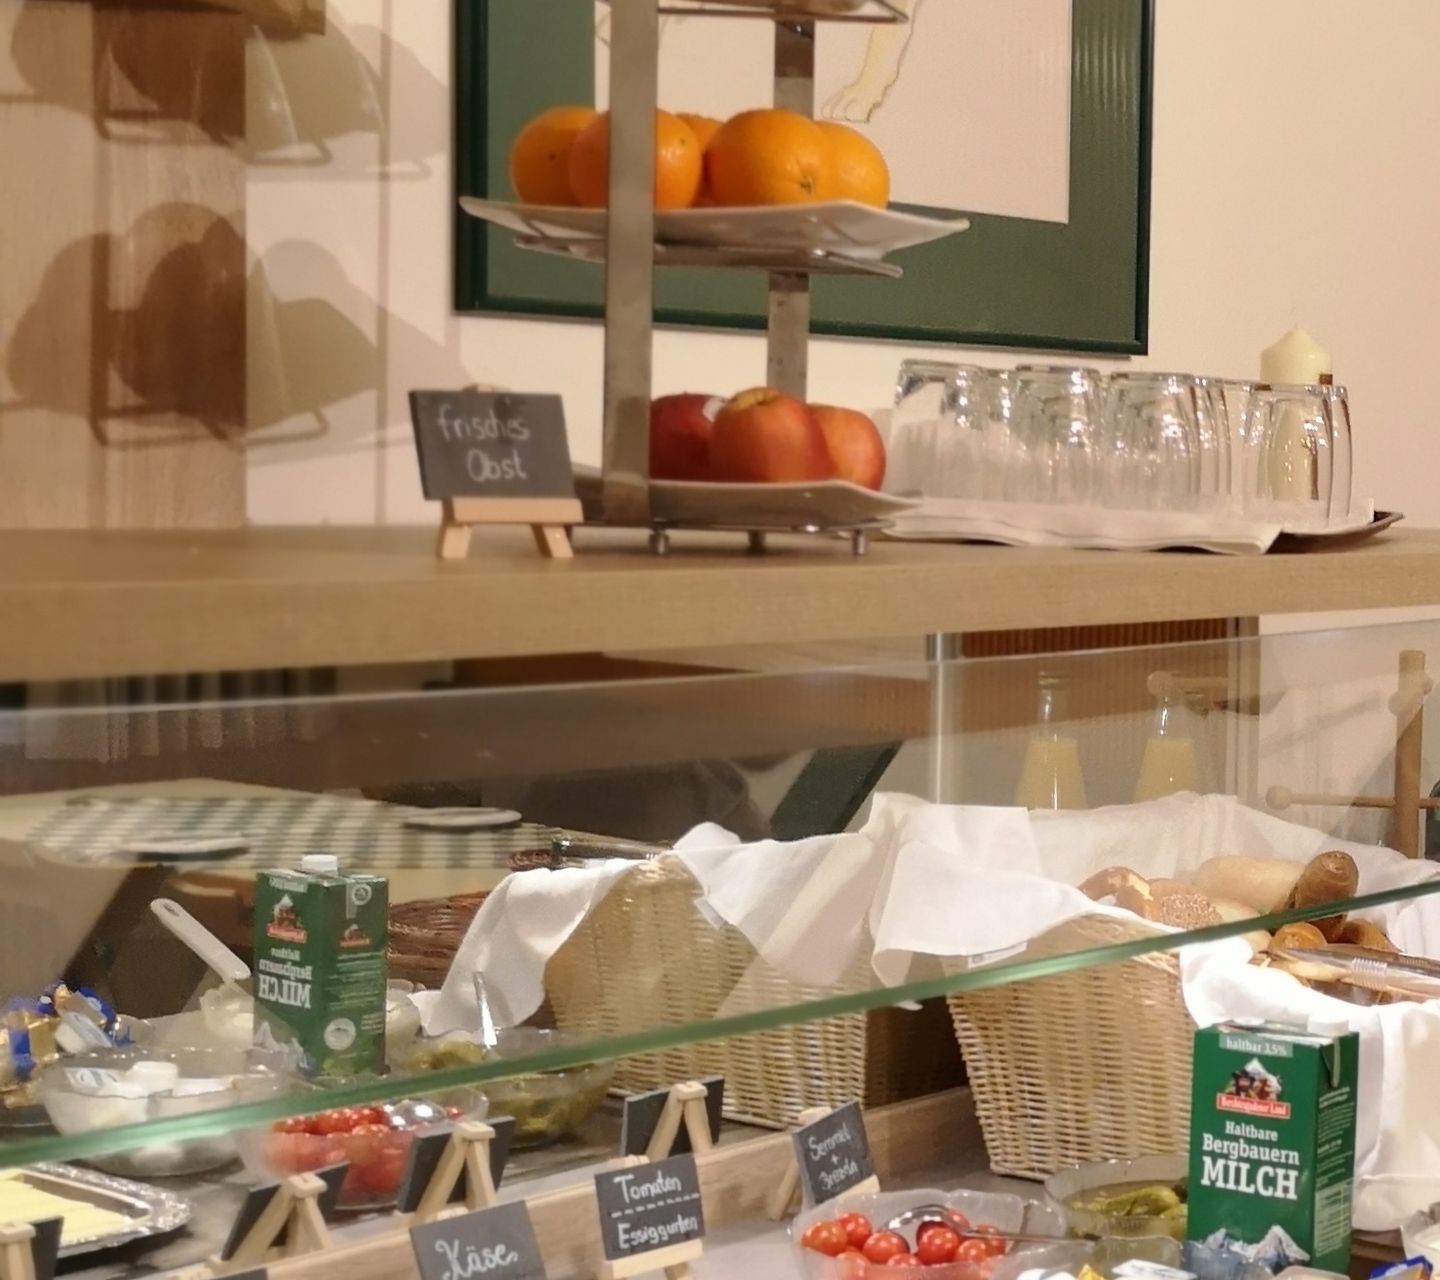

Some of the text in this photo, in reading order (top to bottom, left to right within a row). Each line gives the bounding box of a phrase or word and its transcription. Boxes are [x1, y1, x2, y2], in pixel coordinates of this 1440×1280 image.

[437, 404, 530, 440] frisches
[466, 448, 527, 482] Obst
[1226, 1036, 1262, 1052] haltbar
[808, 1121, 851, 1161] Semmel
[1225, 1121, 1279, 1142] Haltbare
[1203, 1133, 1300, 1165] Bergbauern
[613, 1169, 681, 1203] Tomaten
[1201, 1156, 1299, 1200] MILCH
[618, 1214, 698, 1249] Essiggurken
